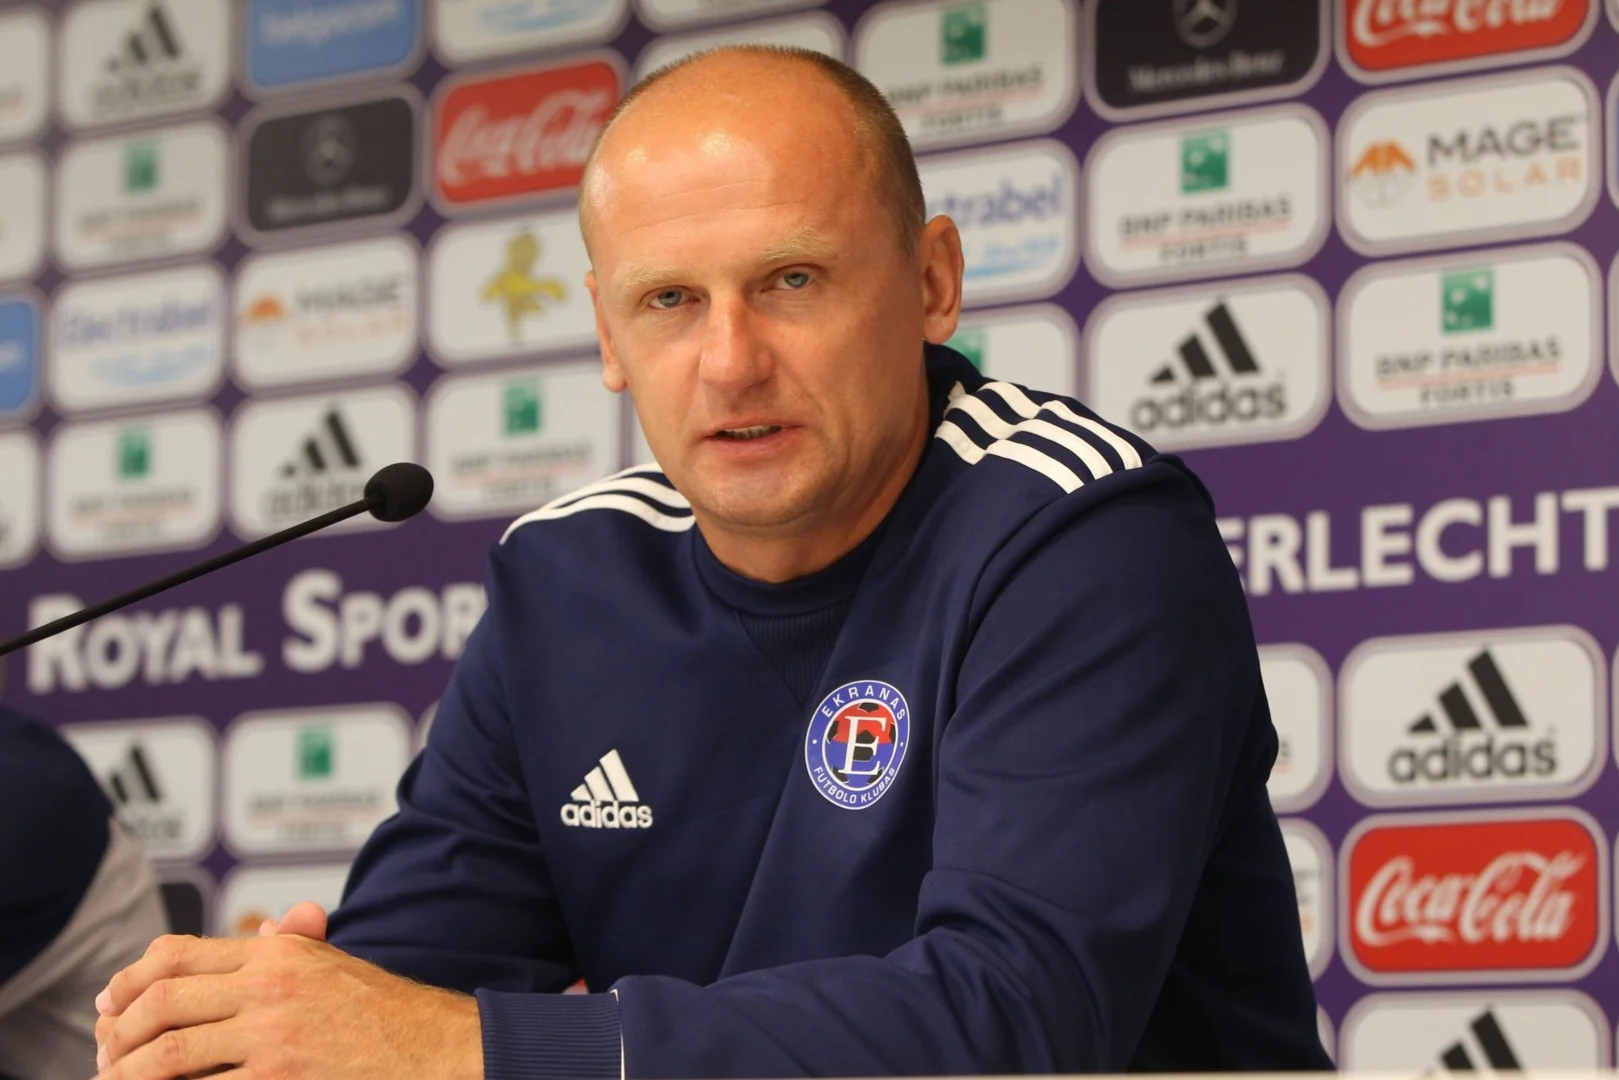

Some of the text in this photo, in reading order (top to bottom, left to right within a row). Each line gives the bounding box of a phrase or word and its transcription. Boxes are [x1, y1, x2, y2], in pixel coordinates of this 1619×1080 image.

[1426, 116, 1580, 167] MAGE
[1425, 156, 1582, 203] SOLAR
[1181, 196, 1291, 224] PARIBAS
[1376, 336, 1561, 377] BNP PARIBAS
[1131, 379, 1285, 431] adidas
[1419, 380, 1513, 402] FORTIS
[1216, 486, 1619, 597] RLECHT
[28, 595, 264, 693] ROYAL
[821, 685, 906, 720] EKRANAS
[1388, 732, 1557, 783] adidas
[814, 766, 896, 804] FUTBOLO KLUBAS
[560, 800, 654, 829] adidas
[1355, 851, 1586, 947] Coca-Cola
